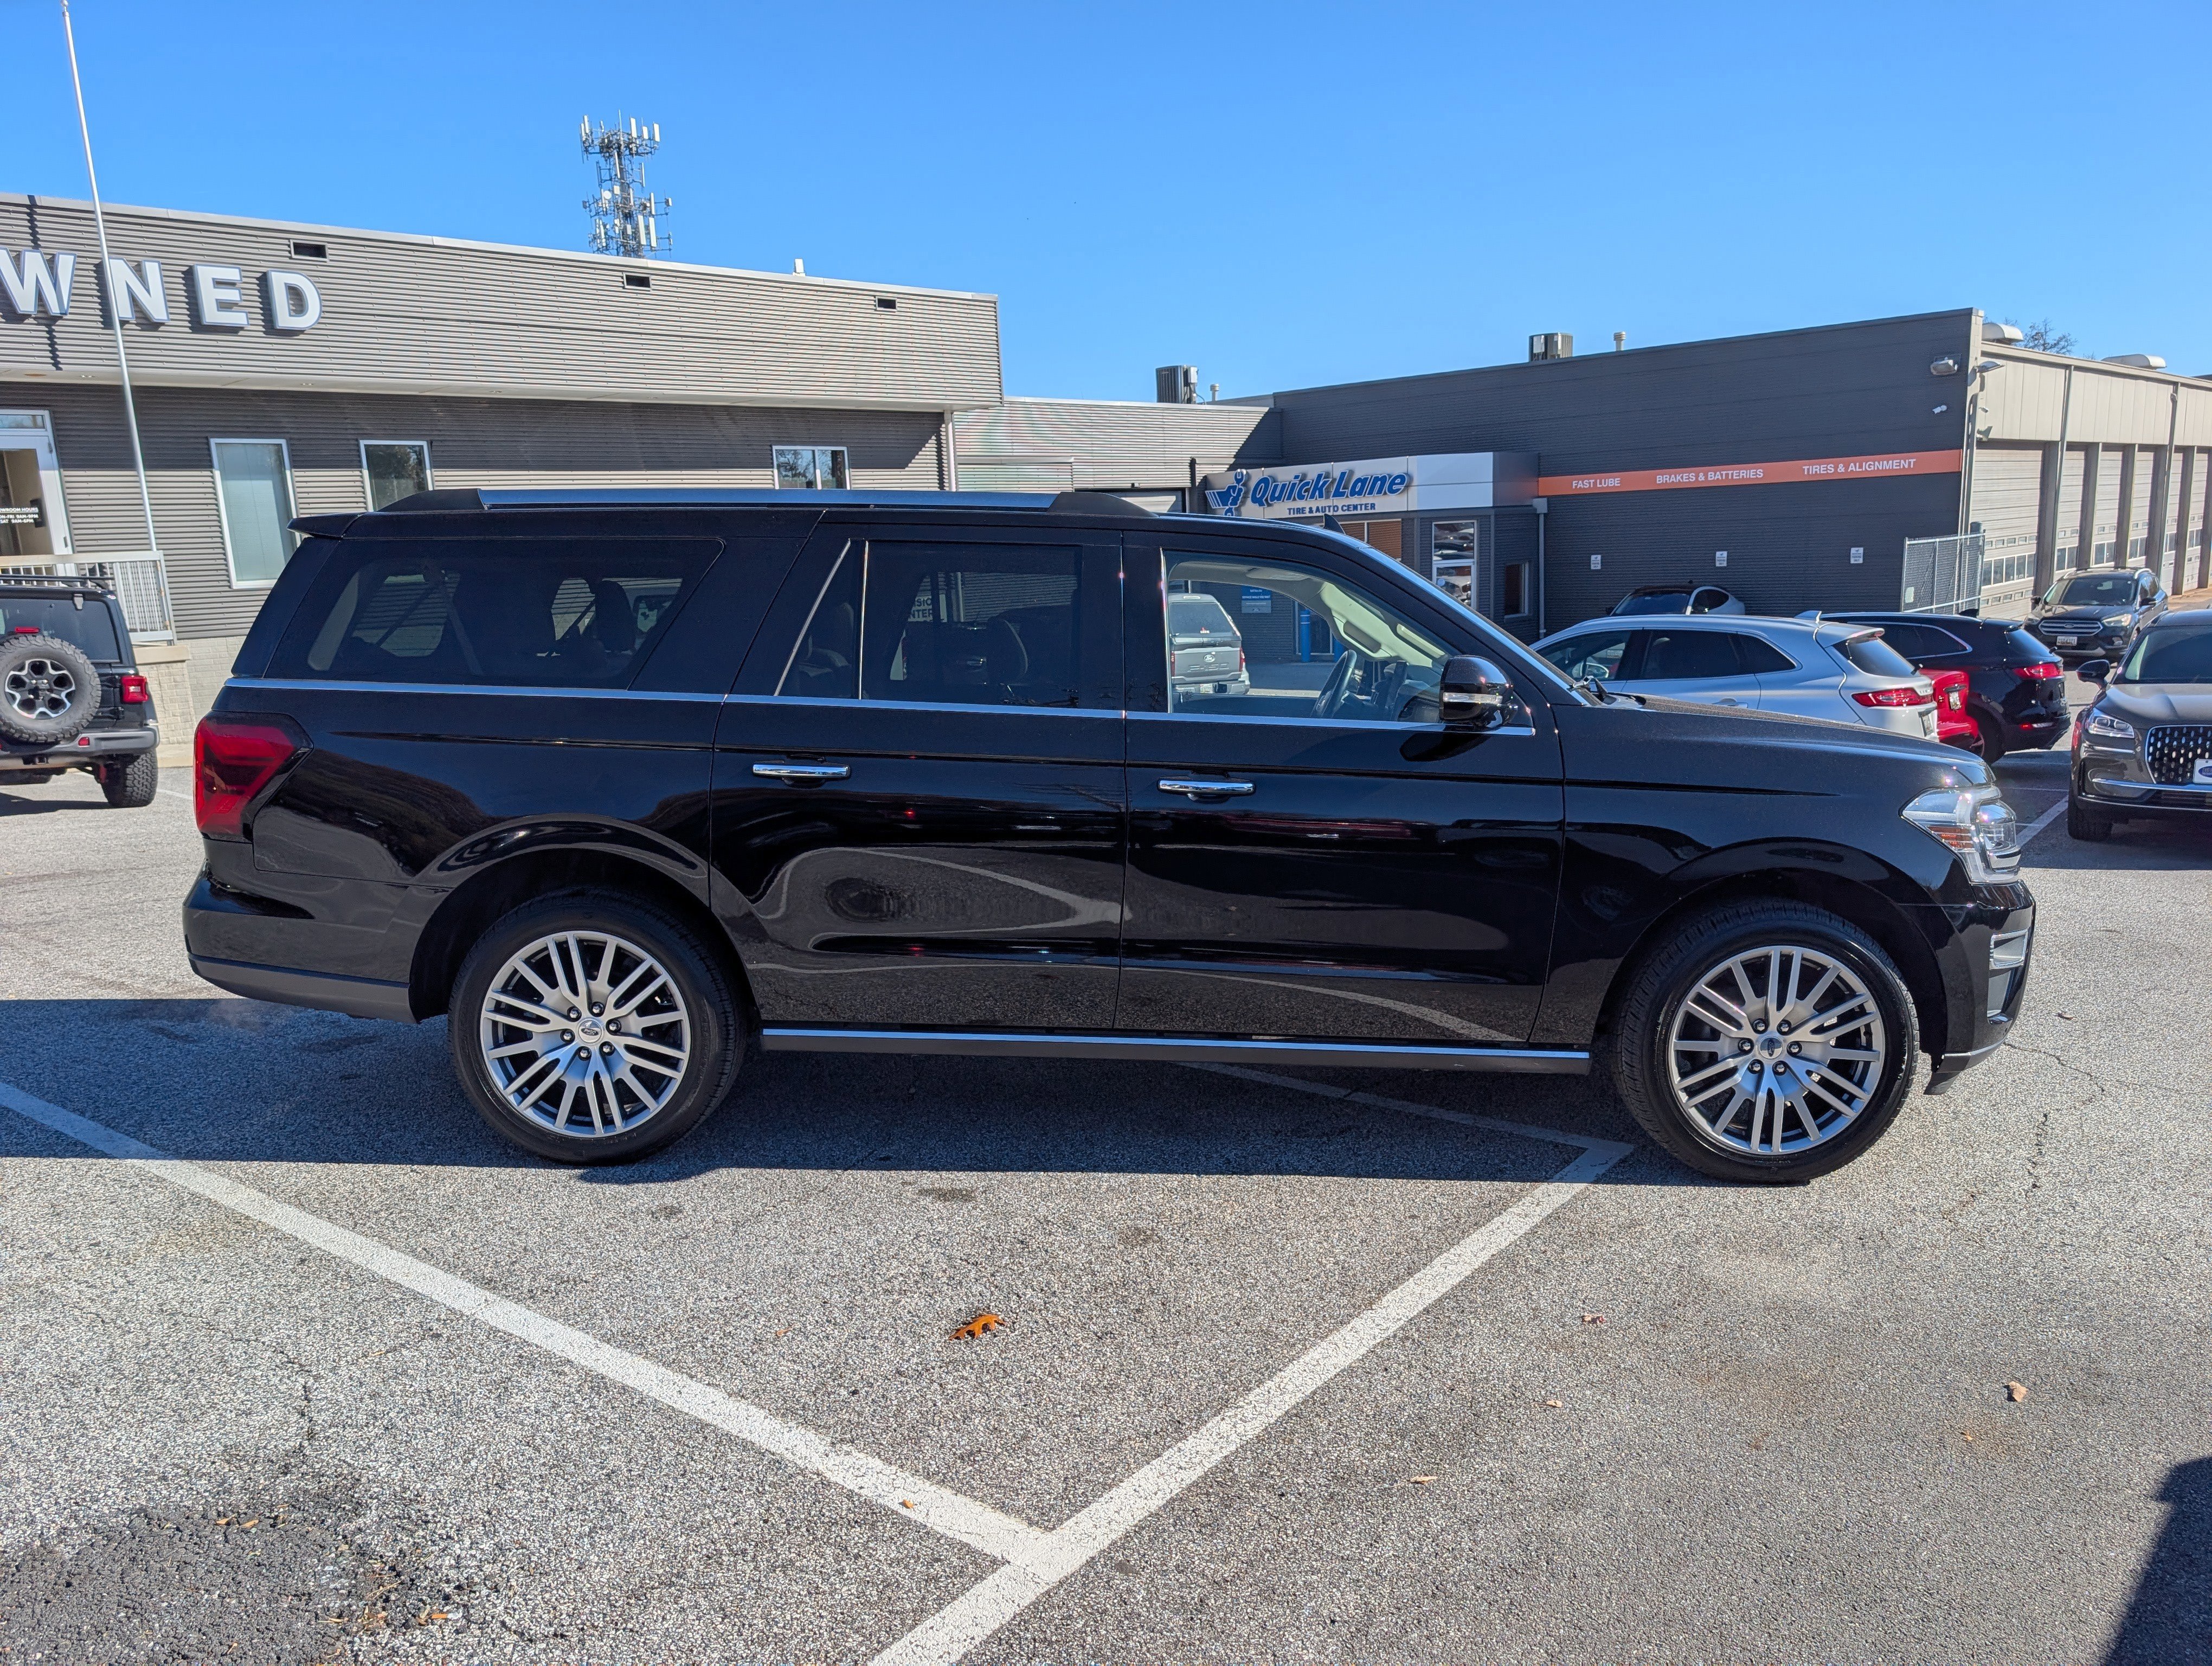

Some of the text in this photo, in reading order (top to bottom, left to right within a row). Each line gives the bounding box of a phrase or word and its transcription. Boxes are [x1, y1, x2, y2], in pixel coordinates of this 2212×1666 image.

[1803, 459, 1917, 475] TIRES & ALIGNMENT
[1572, 477, 1621, 489] FAST LUBE
[1656, 469, 1764, 484] BRAKES & BATTERIES
[1250, 470, 1408, 508] Quick Lane
[1287, 503, 1376, 515] TIRE & AUTO CENTER
